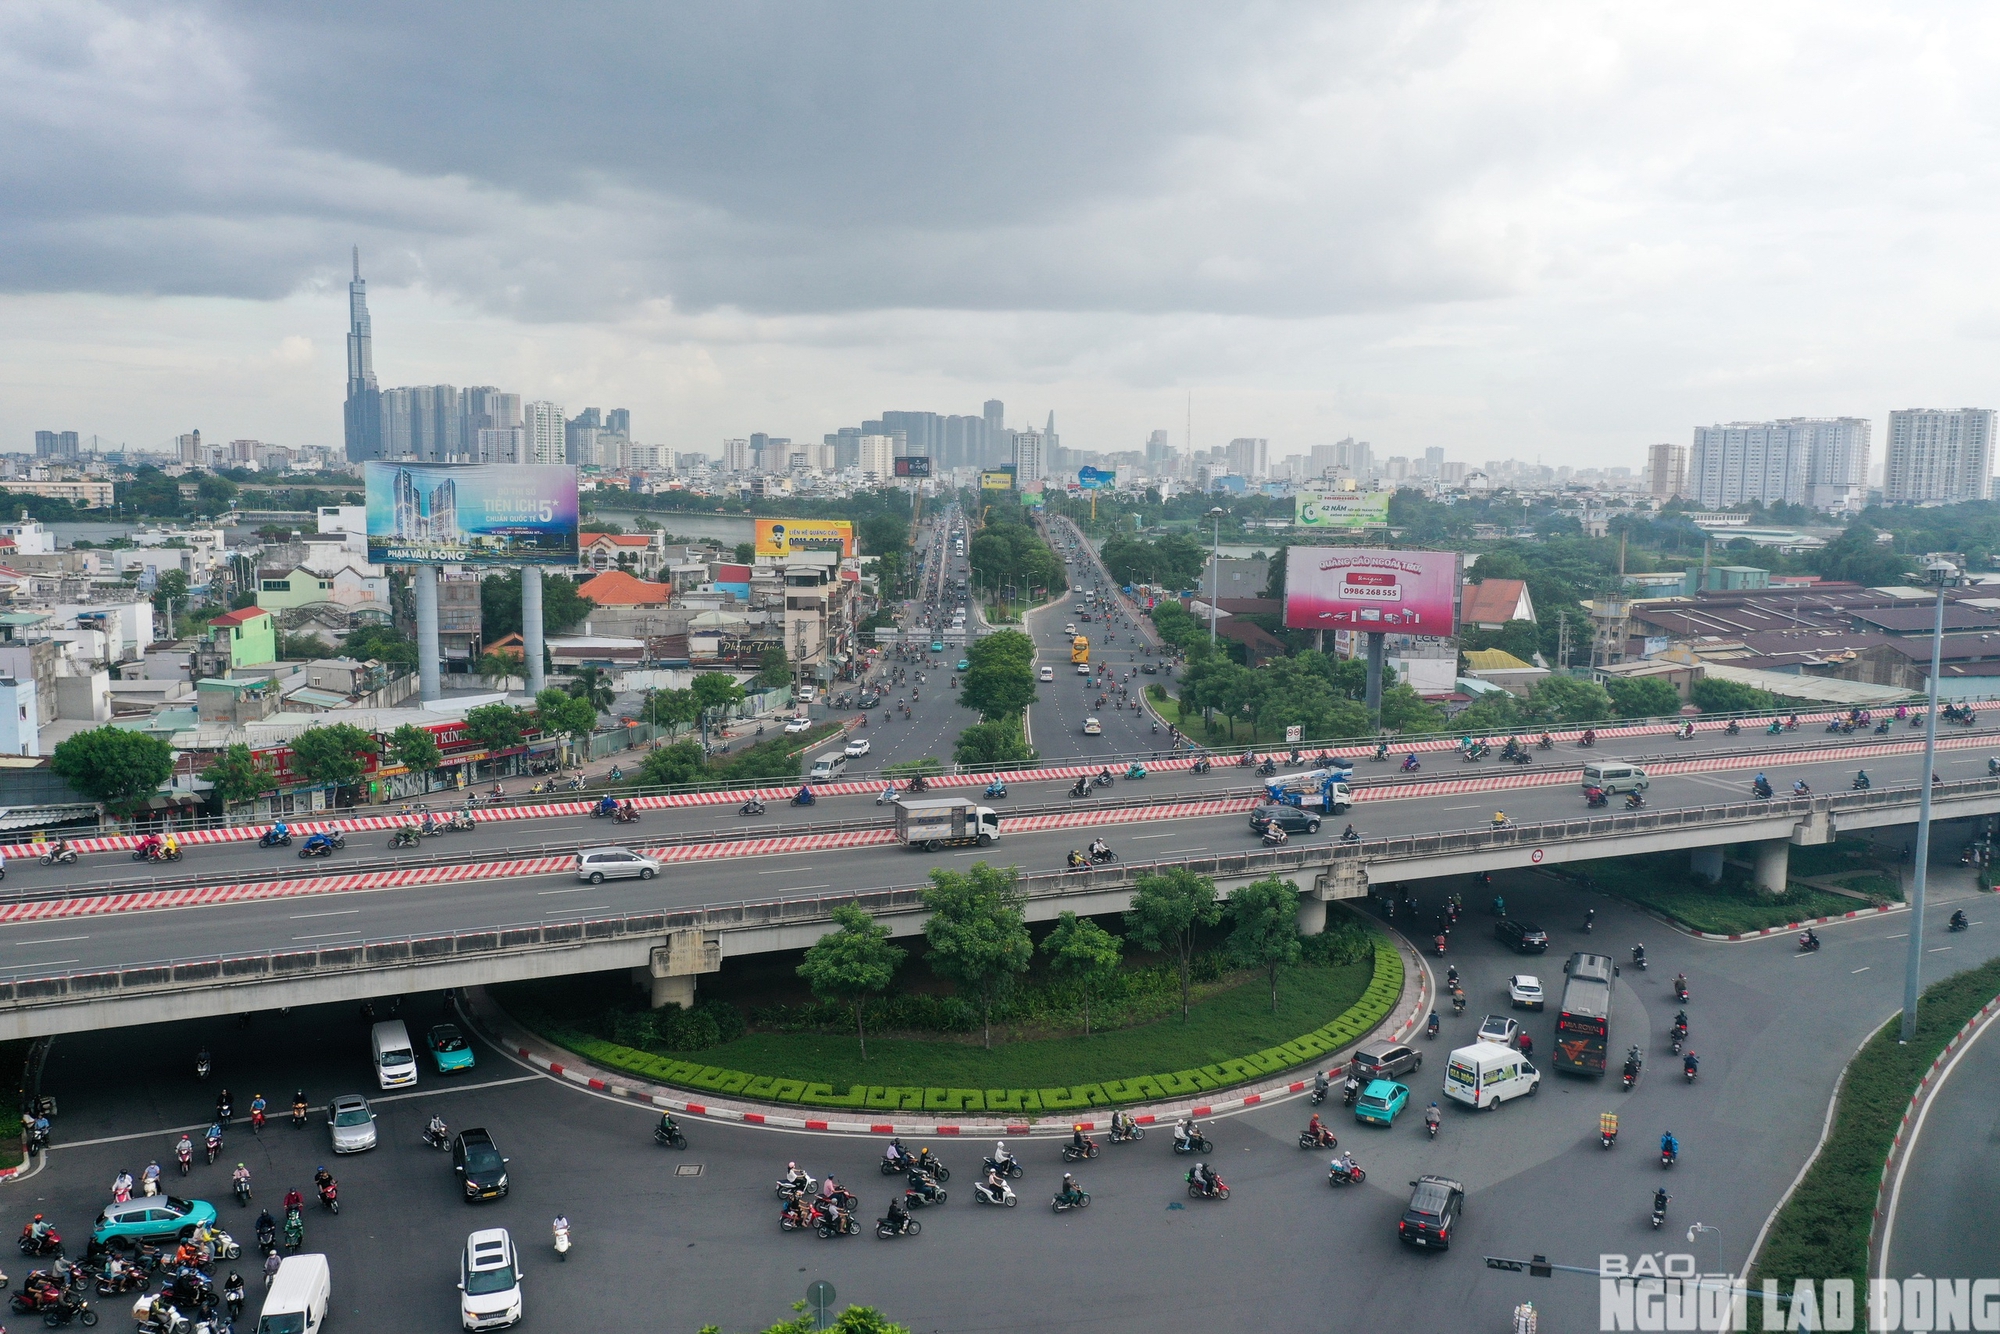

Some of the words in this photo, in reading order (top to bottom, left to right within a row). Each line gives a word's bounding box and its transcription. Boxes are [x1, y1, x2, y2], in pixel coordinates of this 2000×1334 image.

[483, 496, 511, 514] TIỆN
[516, 496, 537, 512] ÍCH
[485, 513, 508, 522] CHUẨN
[509, 513, 528, 523] QUỐC
[529, 513, 537, 522] TẾ
[789, 528, 800, 536] LIÊN
[801, 528, 808, 536] HỆ
[809, 528, 827, 536] QUẢNG
[827, 528, 838, 536] CÁO
[387, 549, 409, 560] PHẠM
[410, 548, 429, 559] VĂN
[1319, 557, 1351, 570] QUẢNG
[1351, 556, 1371, 567] CÁO
[1371, 557, 1401, 570] NGOÀI
[1400, 562, 1423, 575] TRỜI
[1357, 575, 1383, 584] Unique
[1343, 587, 1365, 595] 0986
[1365, 588, 1381, 596] 268
[1382, 589, 1397, 597] 555
[721, 641, 752, 654] Phng
